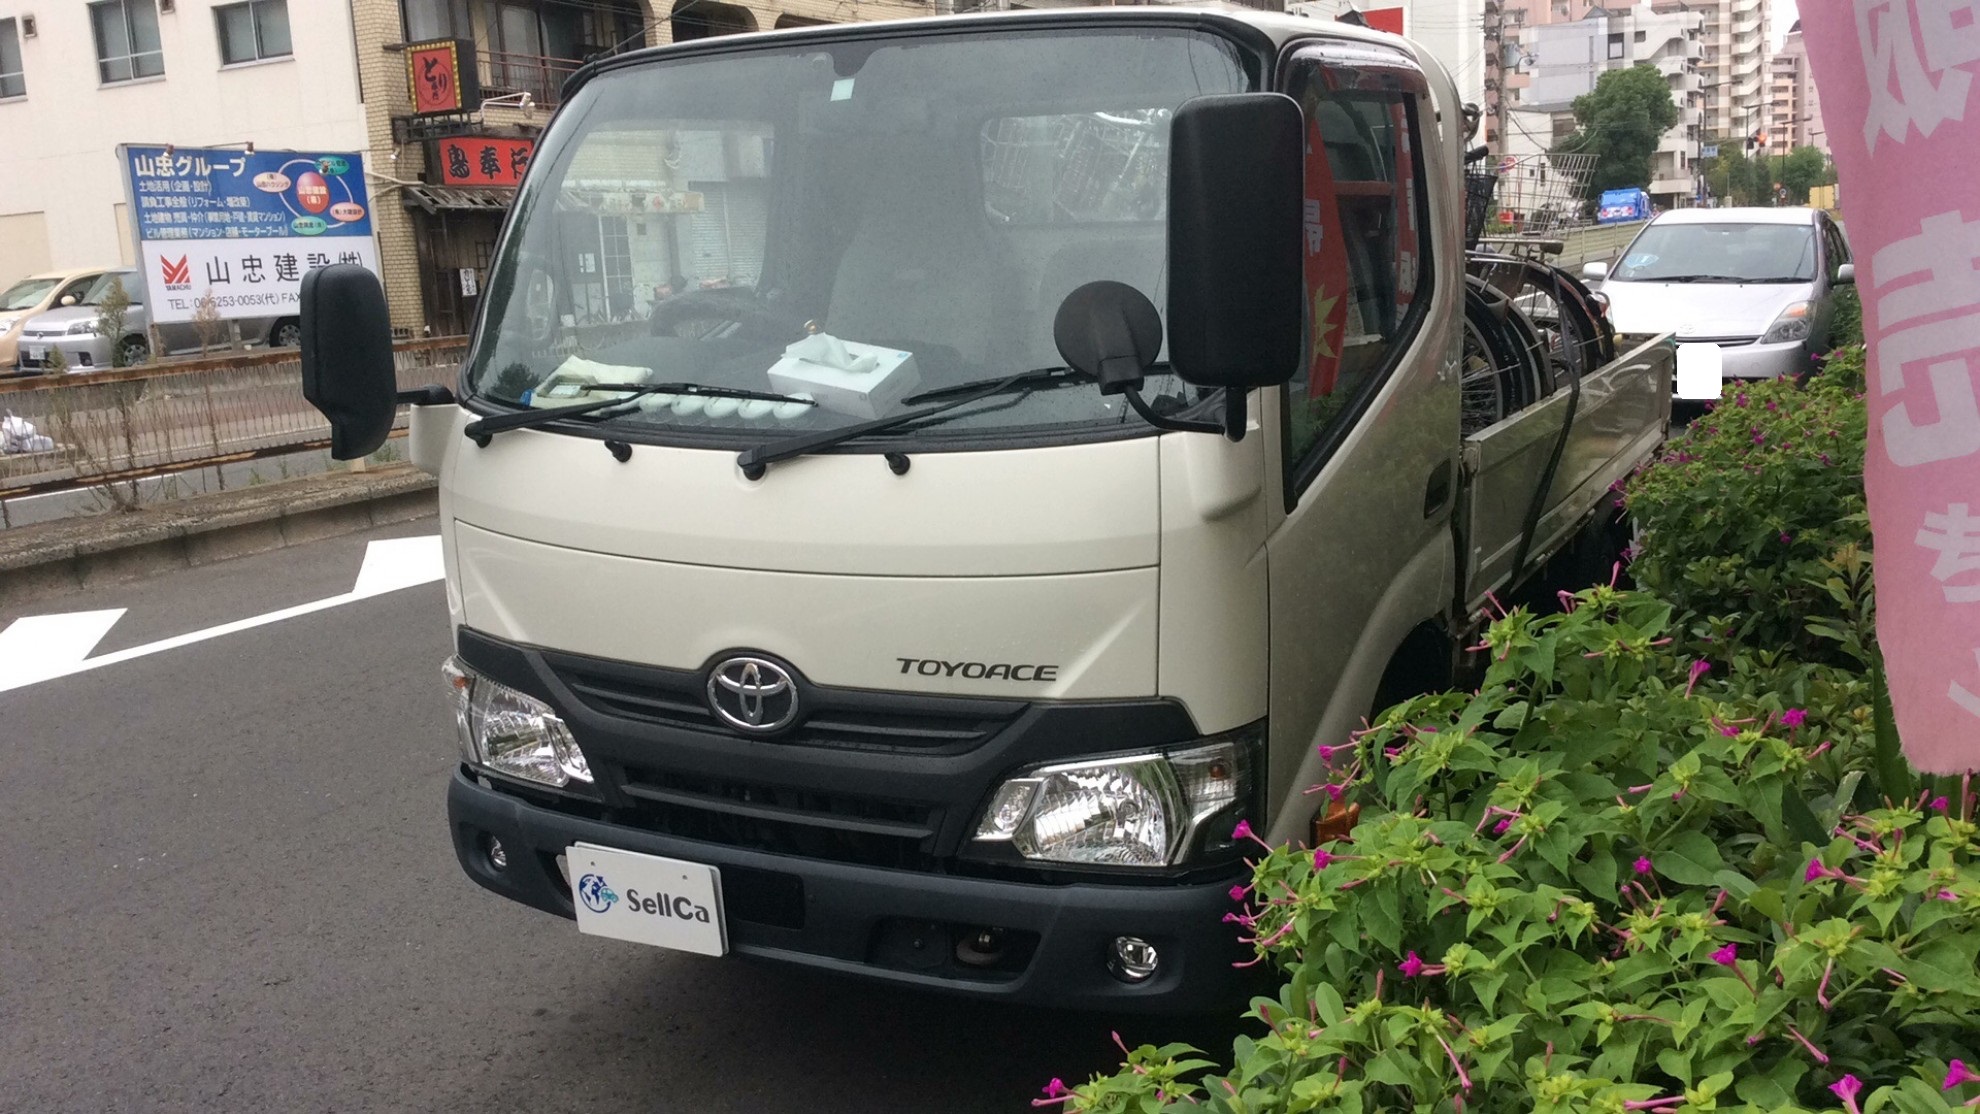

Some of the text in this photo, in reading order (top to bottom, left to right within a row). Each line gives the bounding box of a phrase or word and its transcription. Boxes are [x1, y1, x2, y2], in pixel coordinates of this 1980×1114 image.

[134, 154, 246, 177] 山忠グループ
[896, 657, 1059, 682] TOYOACE
